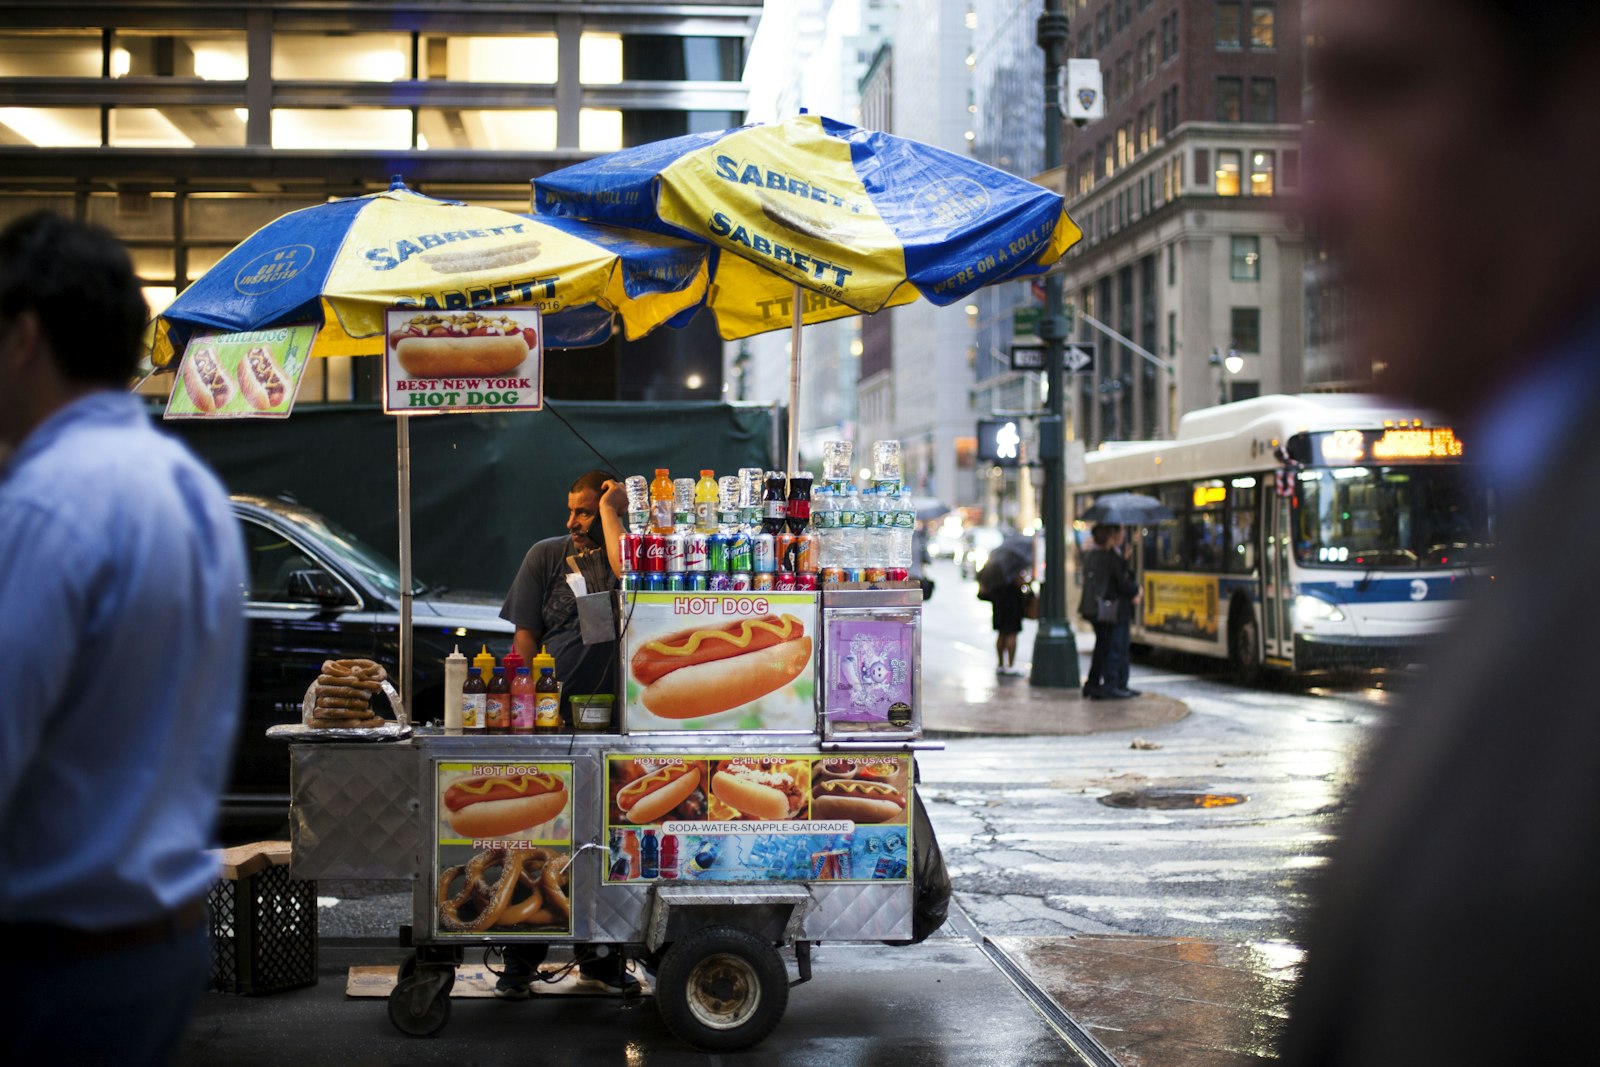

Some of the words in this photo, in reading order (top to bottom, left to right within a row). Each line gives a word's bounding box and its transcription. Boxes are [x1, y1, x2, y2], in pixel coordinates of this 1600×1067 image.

[364, 223, 525, 271] SABRETT
[709, 210, 853, 288] SABRETT
[933, 266, 975, 294] WE'RE
[977, 255, 996, 273] ON
[998, 248, 1008, 262] A
[1008, 230, 1039, 255] ROLL
[239, 268, 298, 285] INSPECTED
[819, 283, 843, 298] 2016
[217, 332, 254, 343] CHILI
[255, 328, 288, 342] DOG
[396, 380, 438, 390] BEST
[442, 379, 481, 390] NEW
[484, 378, 531, 389] YORK
[409, 392, 461, 406] HOT
[467, 391, 519, 405] DOG
[674, 597, 718, 615] HOT
[722, 597, 769, 615] DOG
[633, 757, 656, 765] HOT
[659, 757, 683, 765] DOG
[732, 757, 760, 765] CHILI
[762, 756, 787, 765] DOG
[822, 757, 844, 765] HOT
[847, 756, 898, 765] SAUSAGE
[472, 765, 503, 776] HOT
[506, 765, 538, 776] DOG
[668, 823, 849, 832] SODA-WATER-SNAPPLE-GATORADE
[472, 840, 537, 850] PRETZEL
